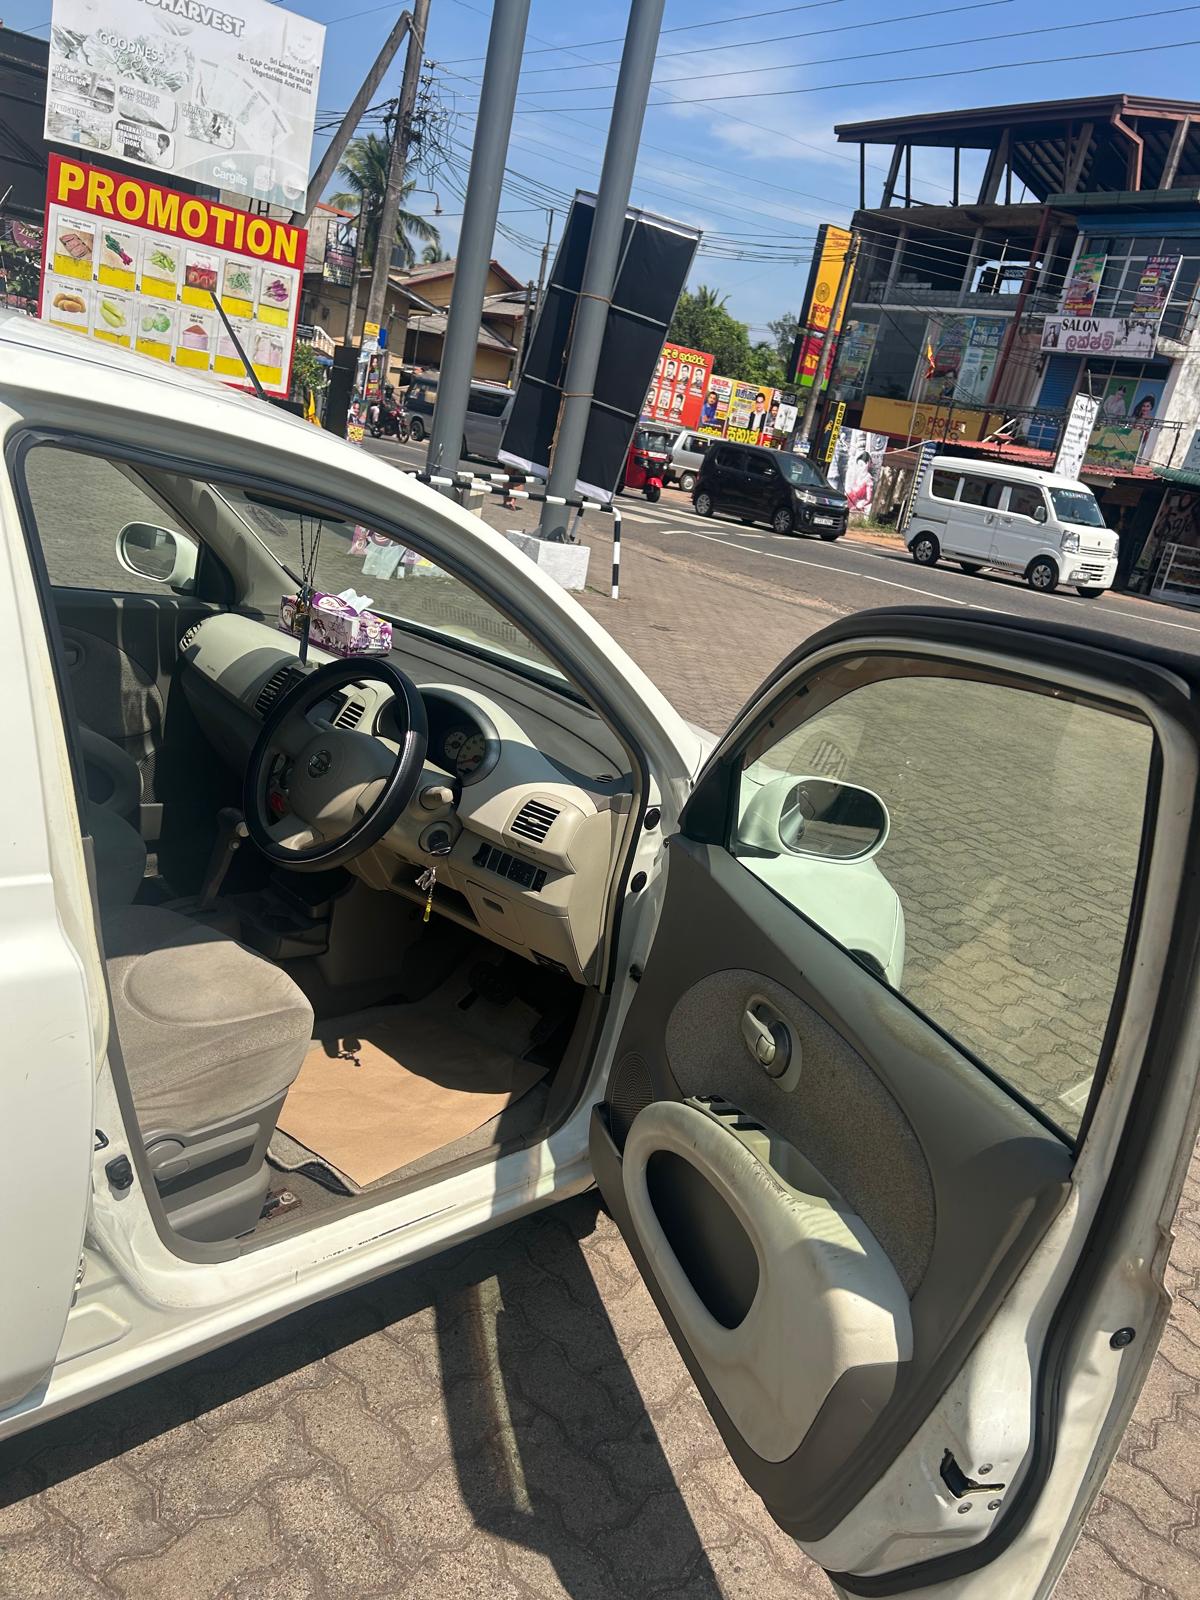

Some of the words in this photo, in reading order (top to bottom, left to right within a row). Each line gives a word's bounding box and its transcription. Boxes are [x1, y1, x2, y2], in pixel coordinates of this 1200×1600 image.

[100, 32, 165, 63] GOODNESS
[238, 53, 246, 61] SL
[264, 62, 288, 78] Certified
[288, 72, 305, 85] Brand
[269, 57, 279, 65] Sri
[279, 60, 300, 74] Lanka's
[300, 67, 314, 79] First
[252, 67, 283, 85] Vegetables
[283, 78, 296, 89] And
[296, 83, 312, 95] Fruits
[212, 166, 248, 186] Cargills
[57, 162, 299, 264] PROMOTION
[1061, 318, 1100, 332] SALON
[802, 351, 820, 370] AT
